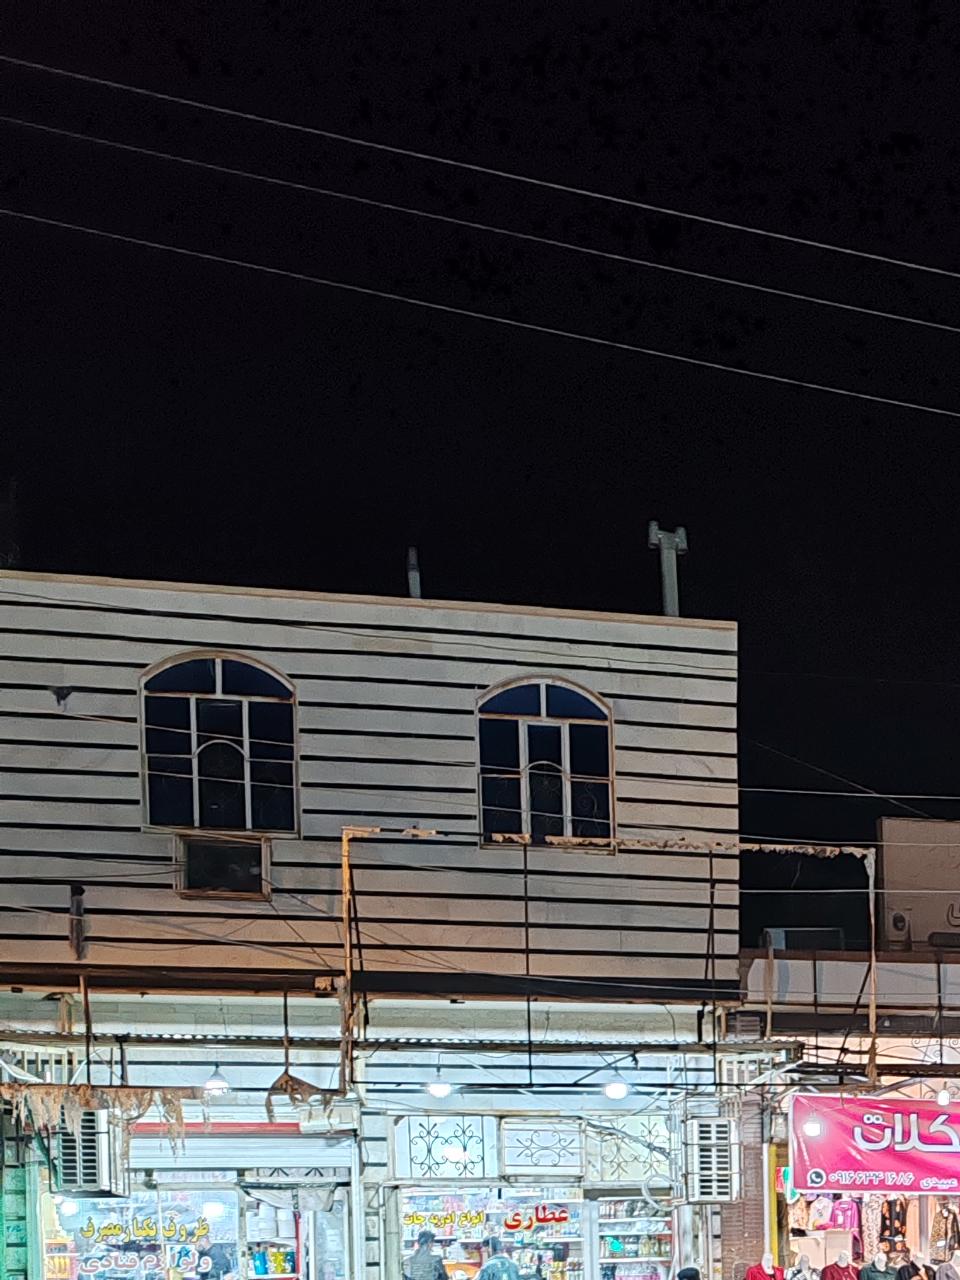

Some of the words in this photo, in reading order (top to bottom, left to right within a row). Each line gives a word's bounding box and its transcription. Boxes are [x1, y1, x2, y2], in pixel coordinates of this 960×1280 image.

[921, 1178, 957, 1189] عبیدی
[80, 1216, 123, 1243] مصرف
[162, 1217, 209, 1242] ظروف
[504, 1206, 568, 1230] عطاری
[80, 1251, 138, 1273] قنادی
